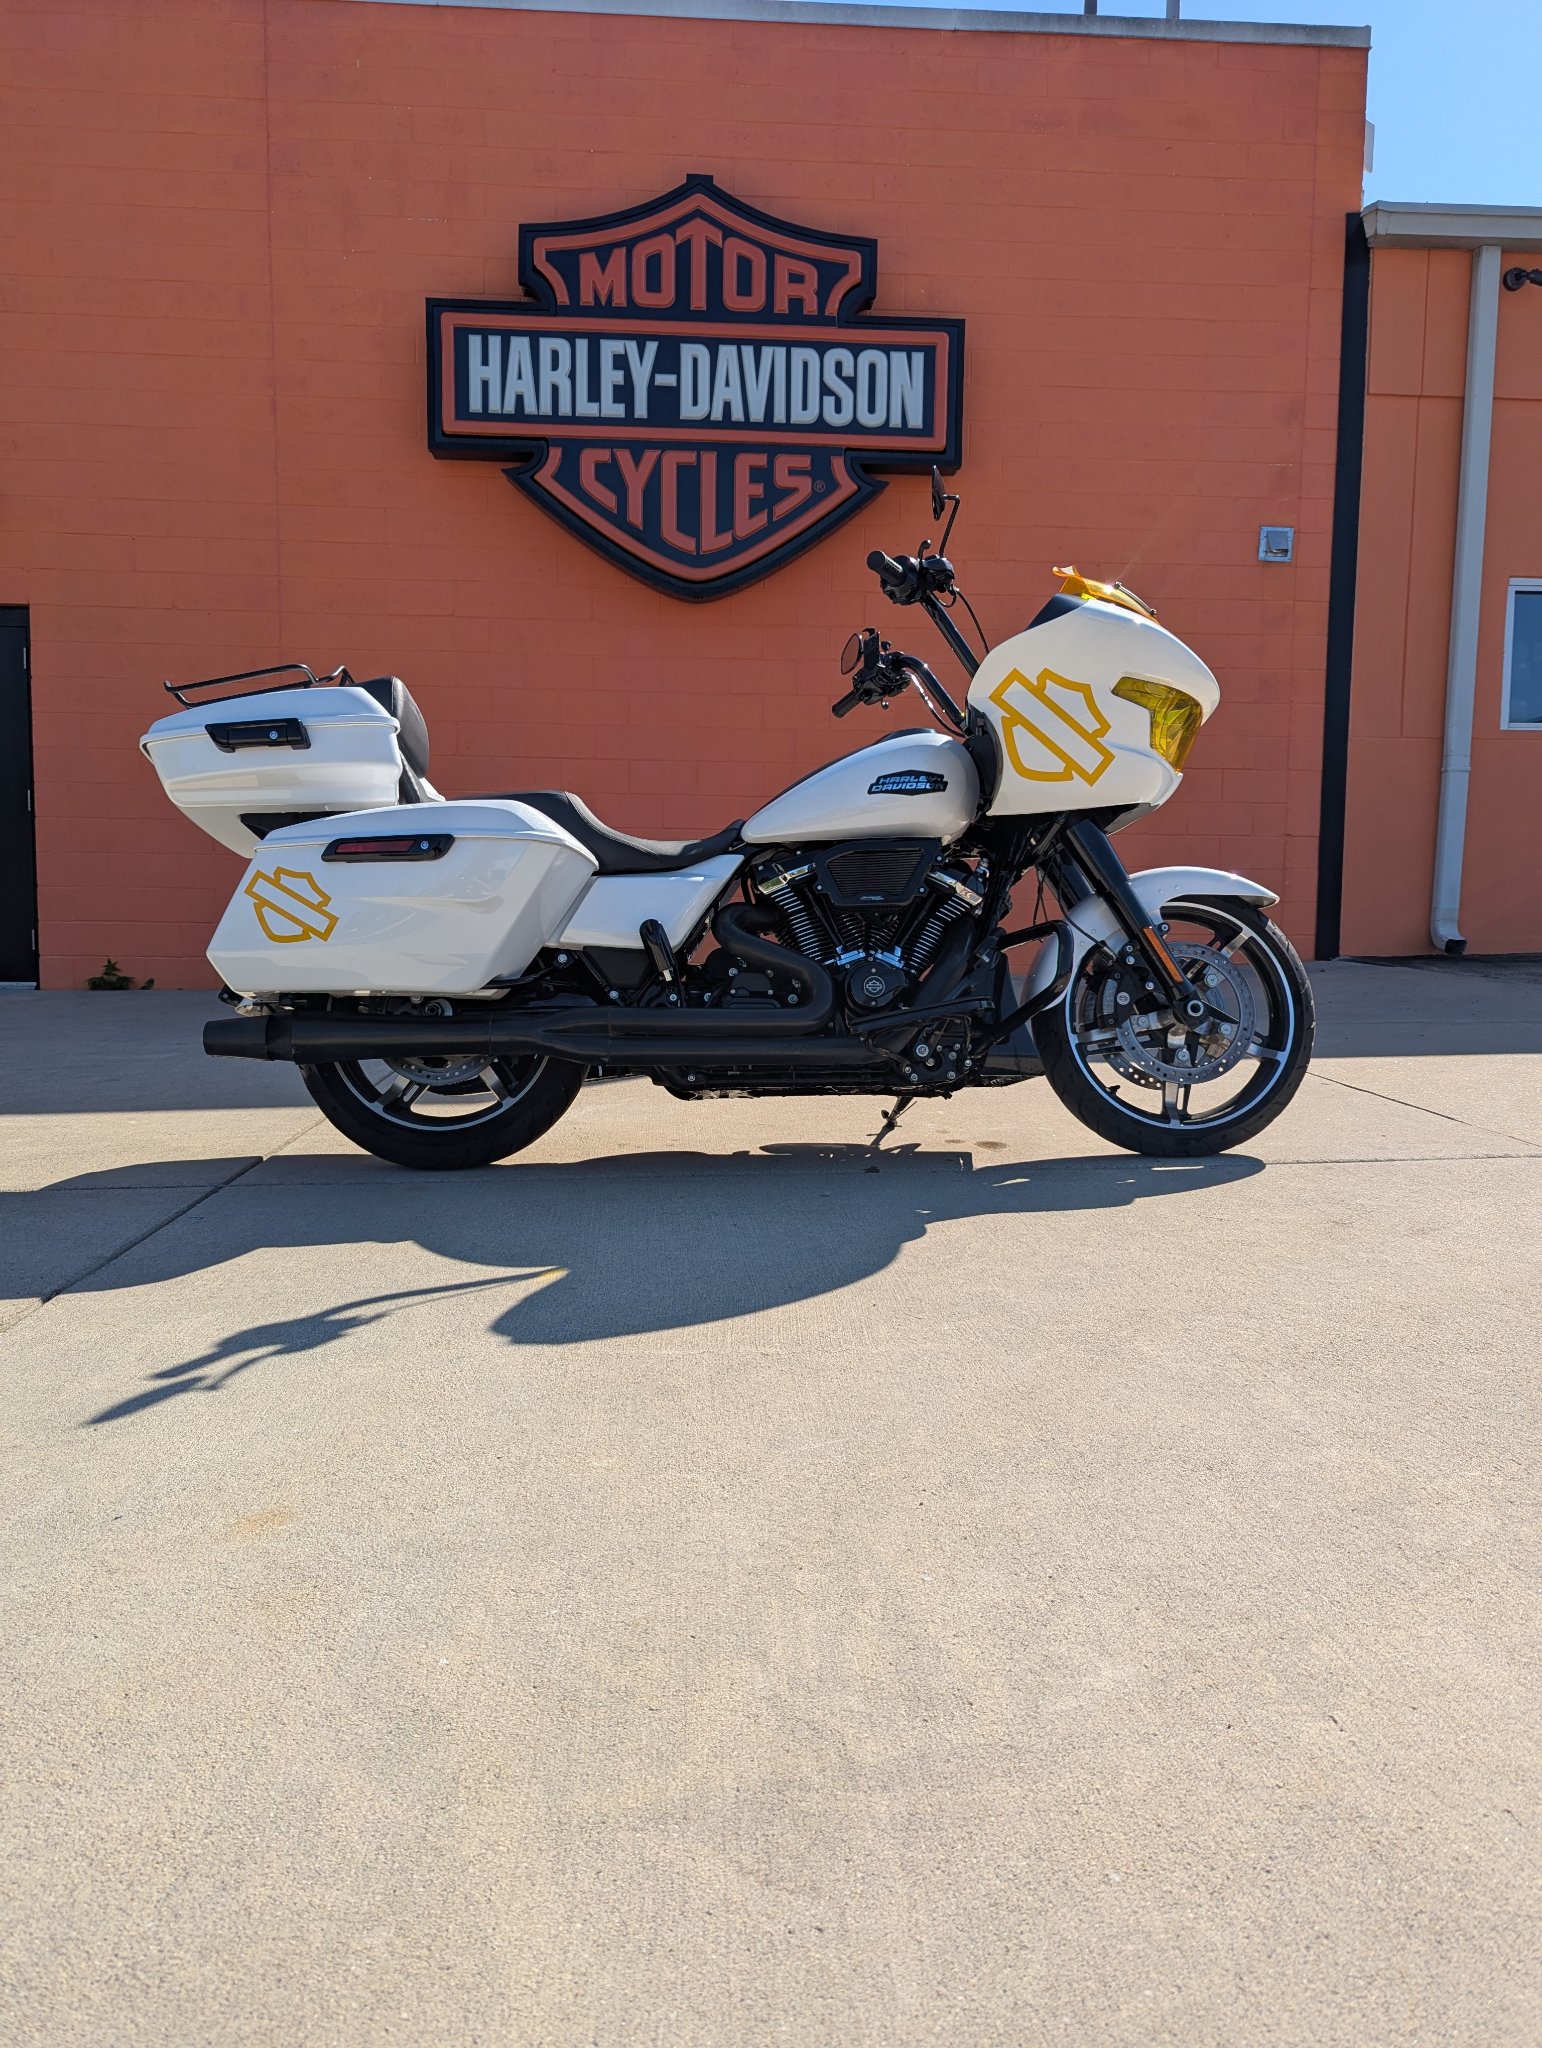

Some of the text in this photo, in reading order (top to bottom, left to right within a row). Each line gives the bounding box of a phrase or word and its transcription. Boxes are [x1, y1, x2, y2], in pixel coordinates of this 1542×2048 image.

[579, 217, 818, 315] MOTOR
[468, 333, 924, 429] HARLEY-DAVIDSON
[579, 448, 813, 555] CYCLES
